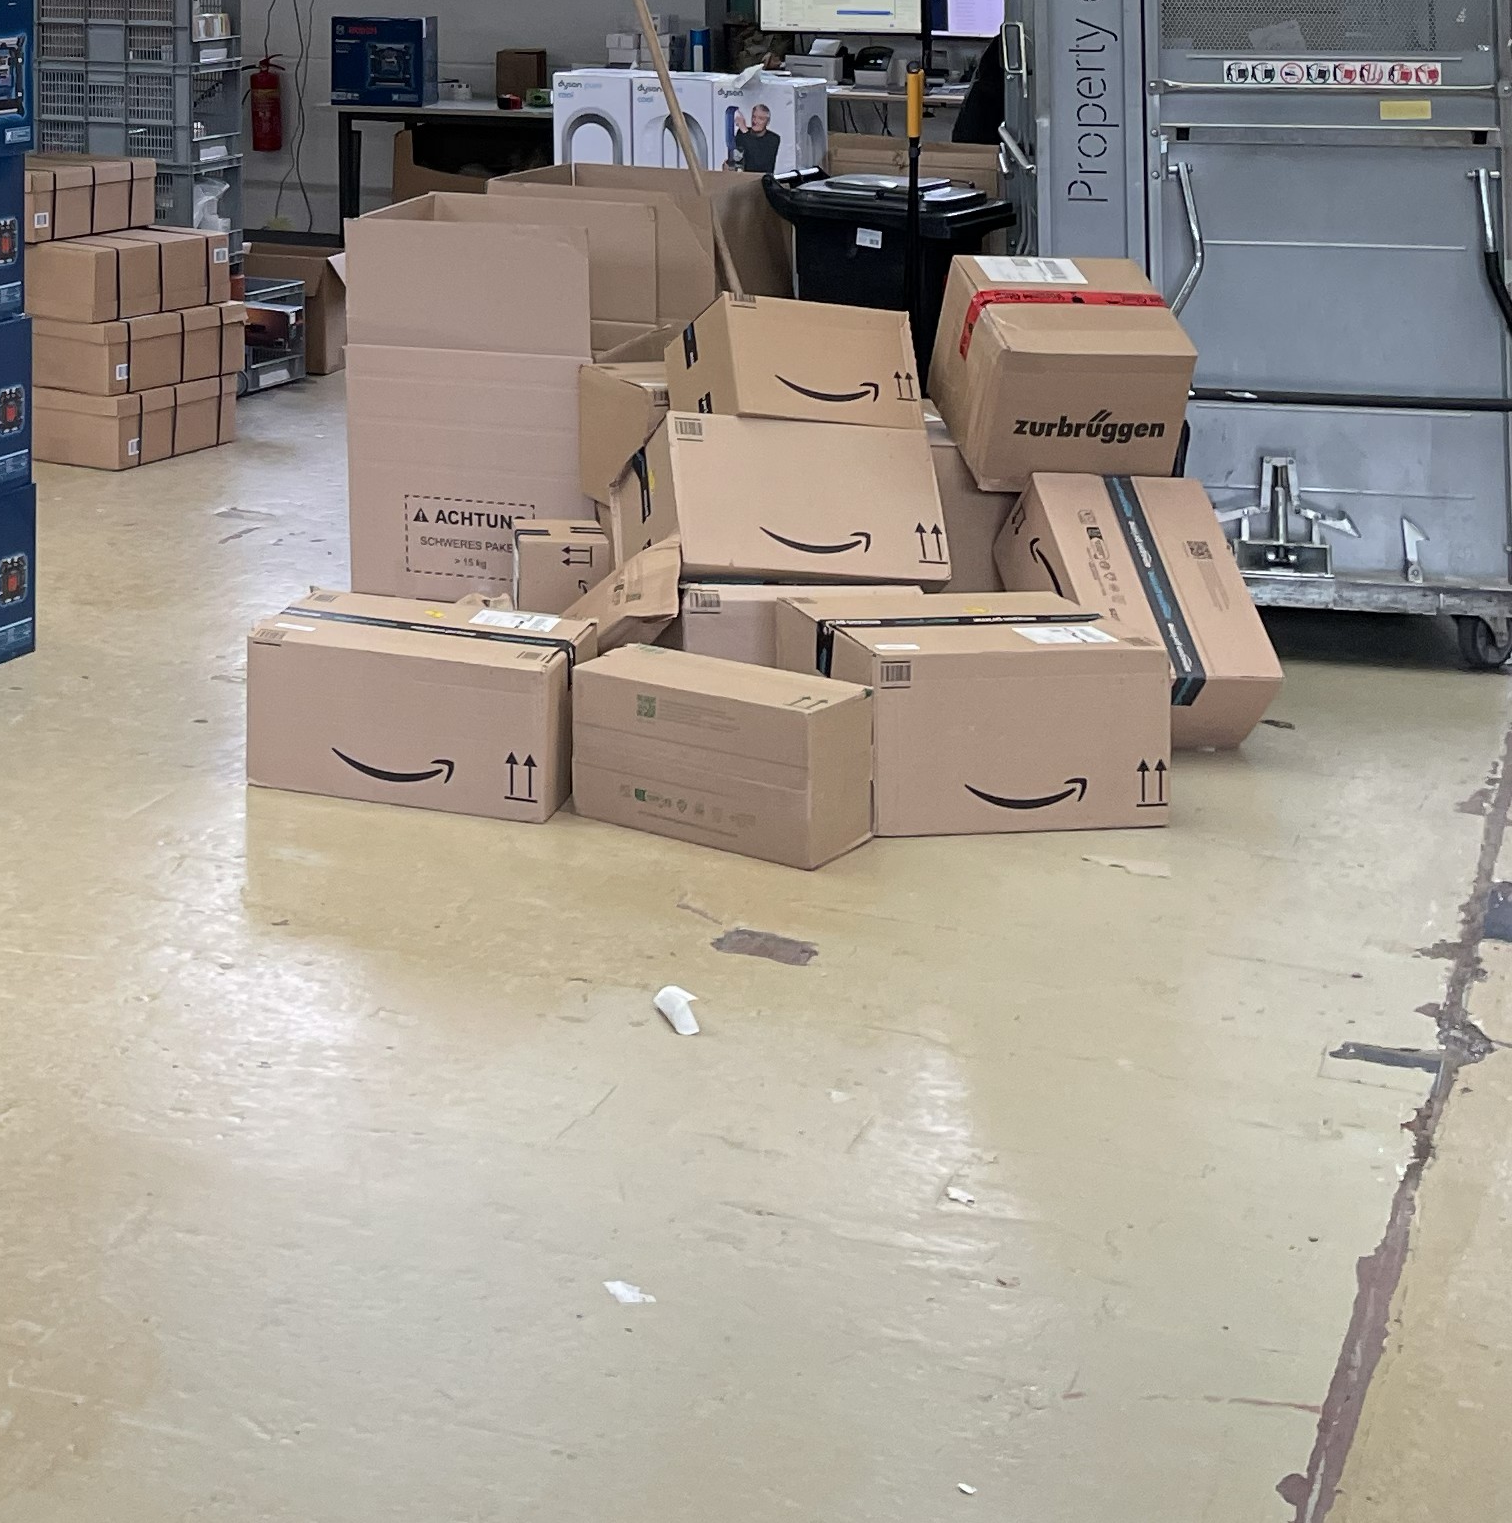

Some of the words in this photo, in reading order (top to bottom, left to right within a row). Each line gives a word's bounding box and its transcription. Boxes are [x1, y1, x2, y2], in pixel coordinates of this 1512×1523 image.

[558, 80, 583, 90] dyson
[637, 83, 663, 94] dyson
[717, 87, 744, 98] dyson
[1067, 18, 1120, 202] Property
[1013, 409, 1165, 444] zurbrüggen
[434, 508, 526, 530] ACHTUN
[420, 535, 482, 551] SCHWERES
[485, 541, 514, 554] PAKE
